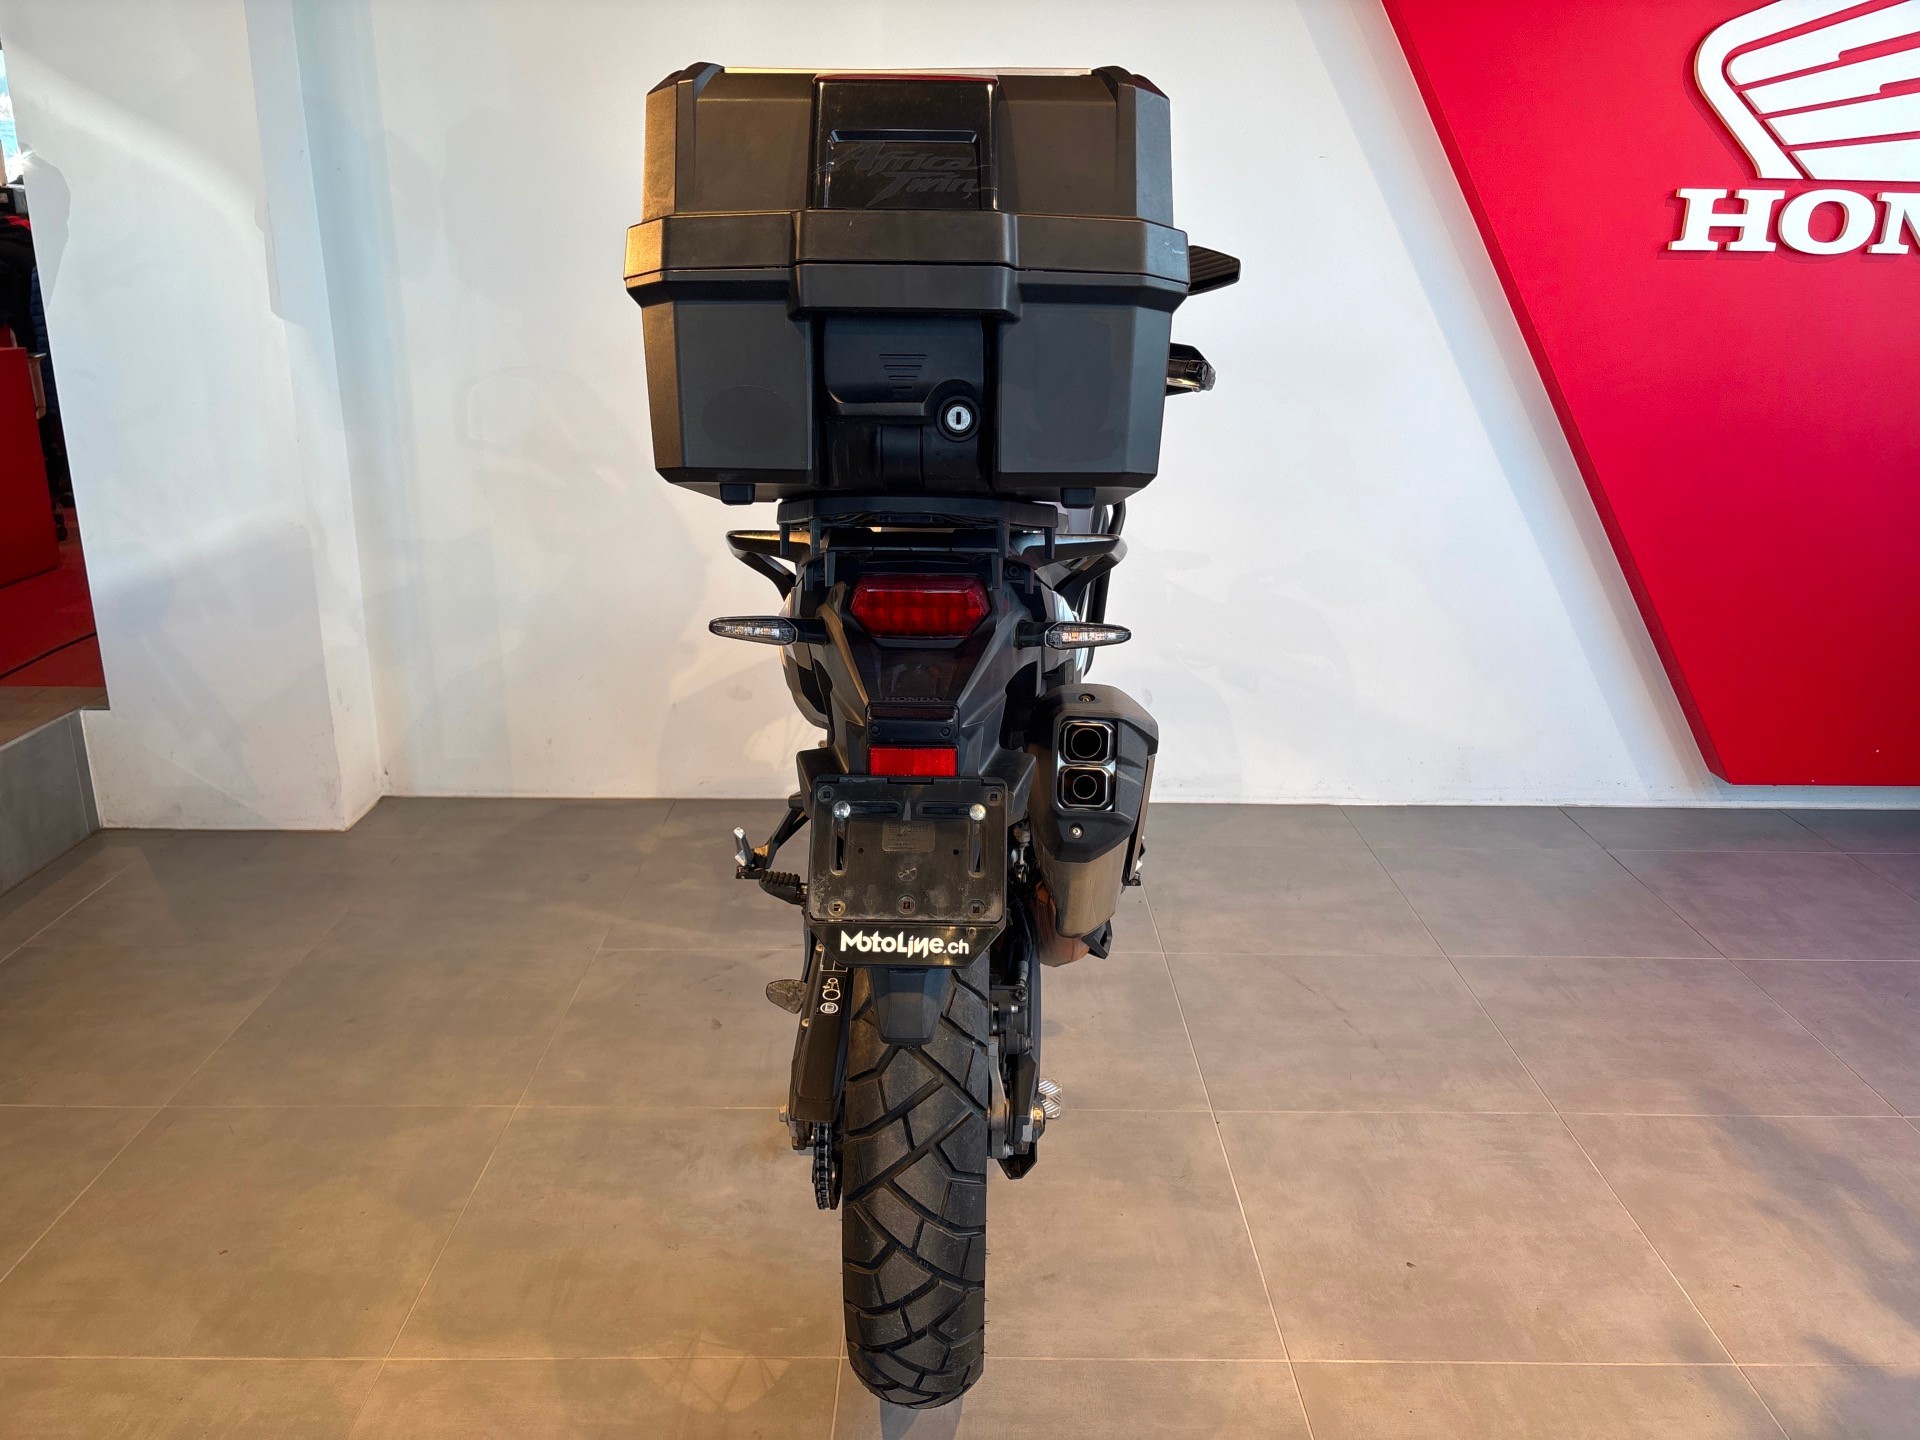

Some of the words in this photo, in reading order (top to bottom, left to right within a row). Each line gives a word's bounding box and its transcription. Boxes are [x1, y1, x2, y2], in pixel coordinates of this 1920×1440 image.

[815, 140, 988, 177] Africa
[866, 170, 990, 207] Twin
[882, 695, 944, 703] HONDA
